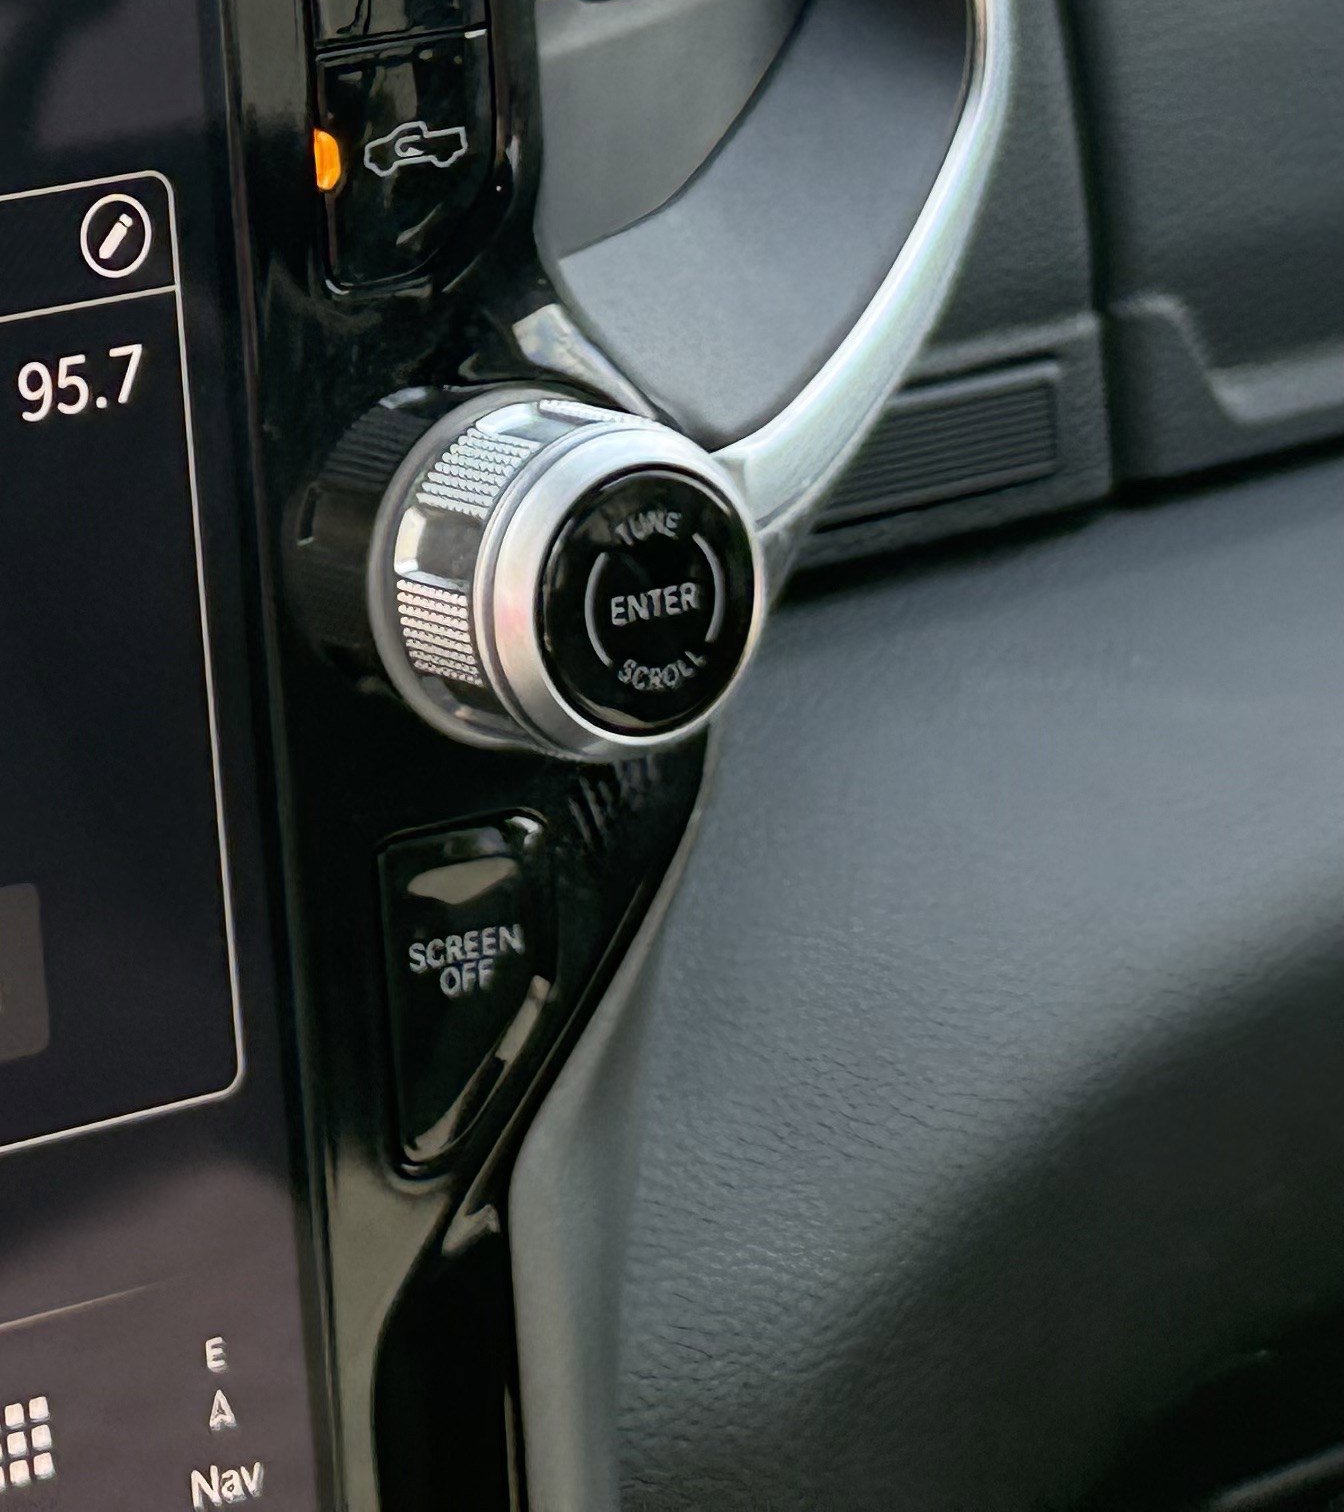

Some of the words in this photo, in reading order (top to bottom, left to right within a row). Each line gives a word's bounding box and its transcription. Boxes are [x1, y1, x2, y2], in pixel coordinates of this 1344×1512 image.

[16, 342, 145, 424] 95.7
[614, 510, 682, 547] TUNE
[611, 581, 701, 627] ENTER
[618, 650, 707, 691] SCROLL
[408, 924, 525, 974] SCREEN
[440, 957, 494, 999] OFF
[205, 1336, 229, 1372] E
[191, 1461, 264, 1512] Nav
